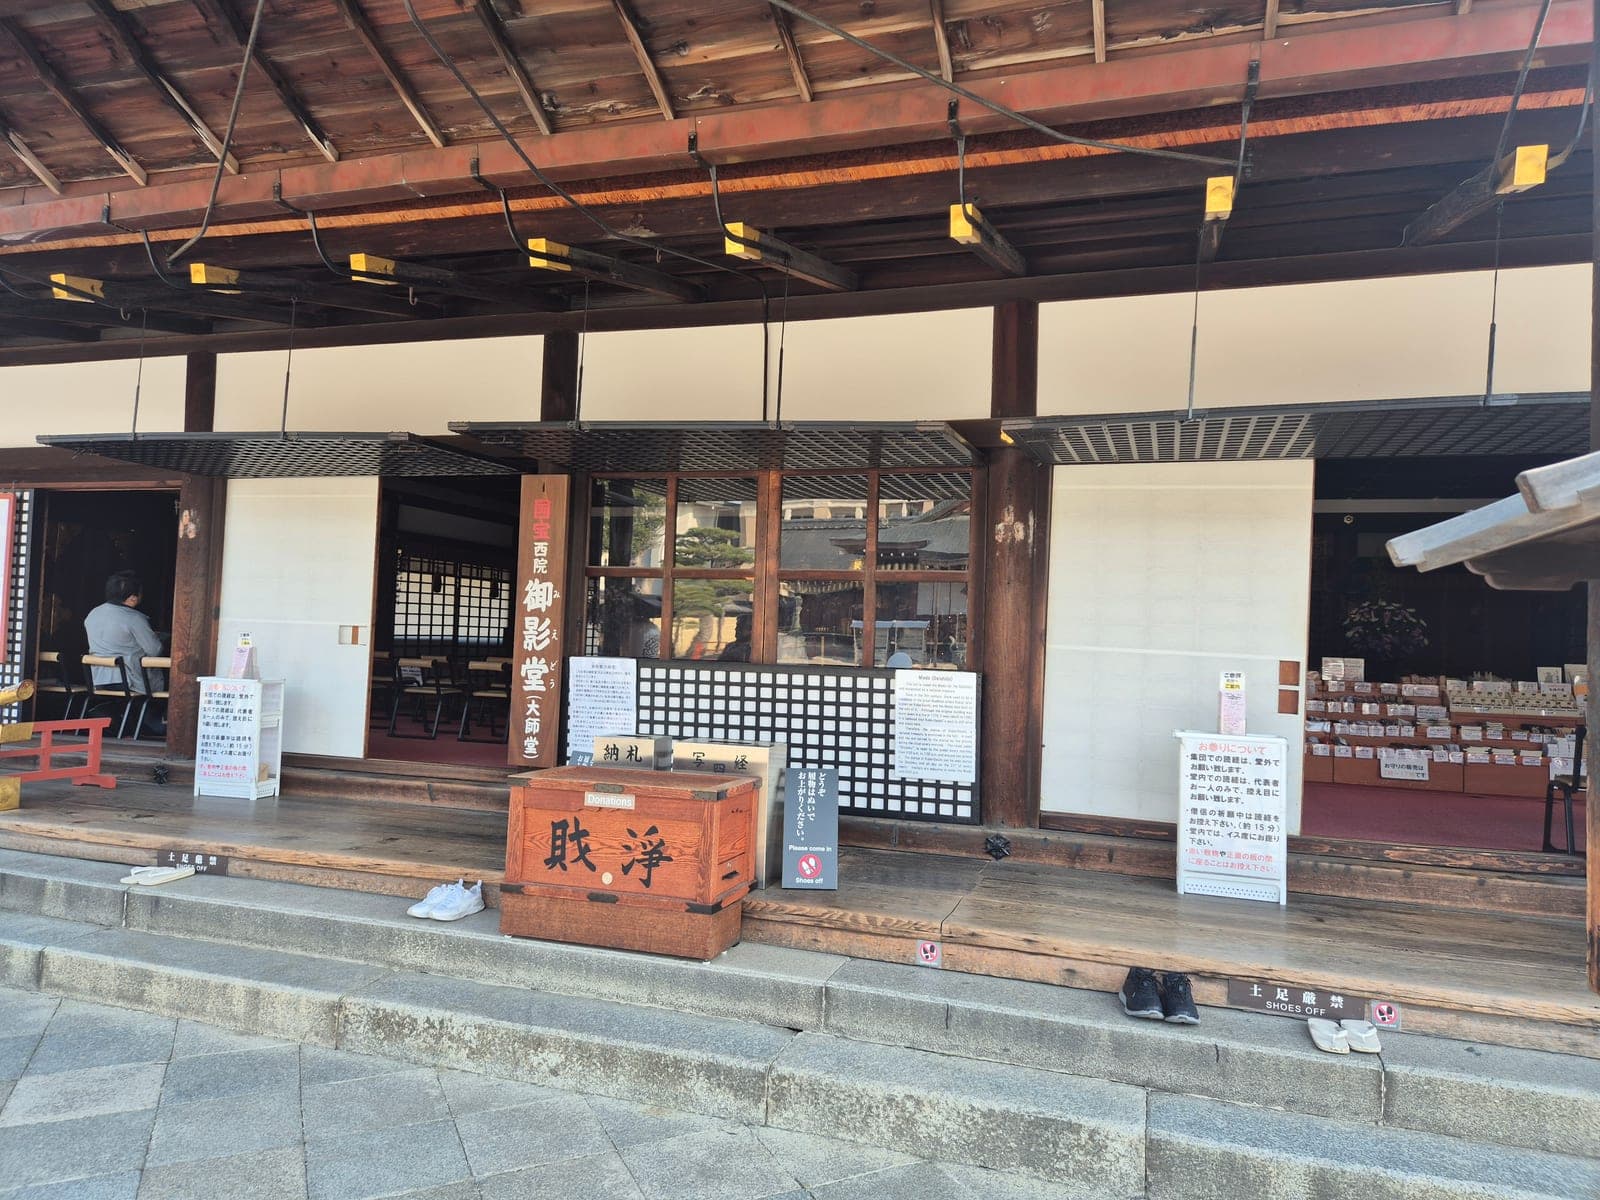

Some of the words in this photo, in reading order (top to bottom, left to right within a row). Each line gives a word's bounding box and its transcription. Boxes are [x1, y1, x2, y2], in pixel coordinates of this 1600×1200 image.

[533, 542, 549, 574] 西院
[520, 578, 554, 692] 御影堂
[603, 743, 643, 763] 納札
[818, 772, 827, 798] どうぞ
[587, 794, 632, 807] Donations
[788, 844, 808, 852] Please
[1249, 984, 1344, 1009] 土足厳禁
[1265, 1001, 1301, 1013] SHOES
[1304, 1006, 1327, 1016] OFF
